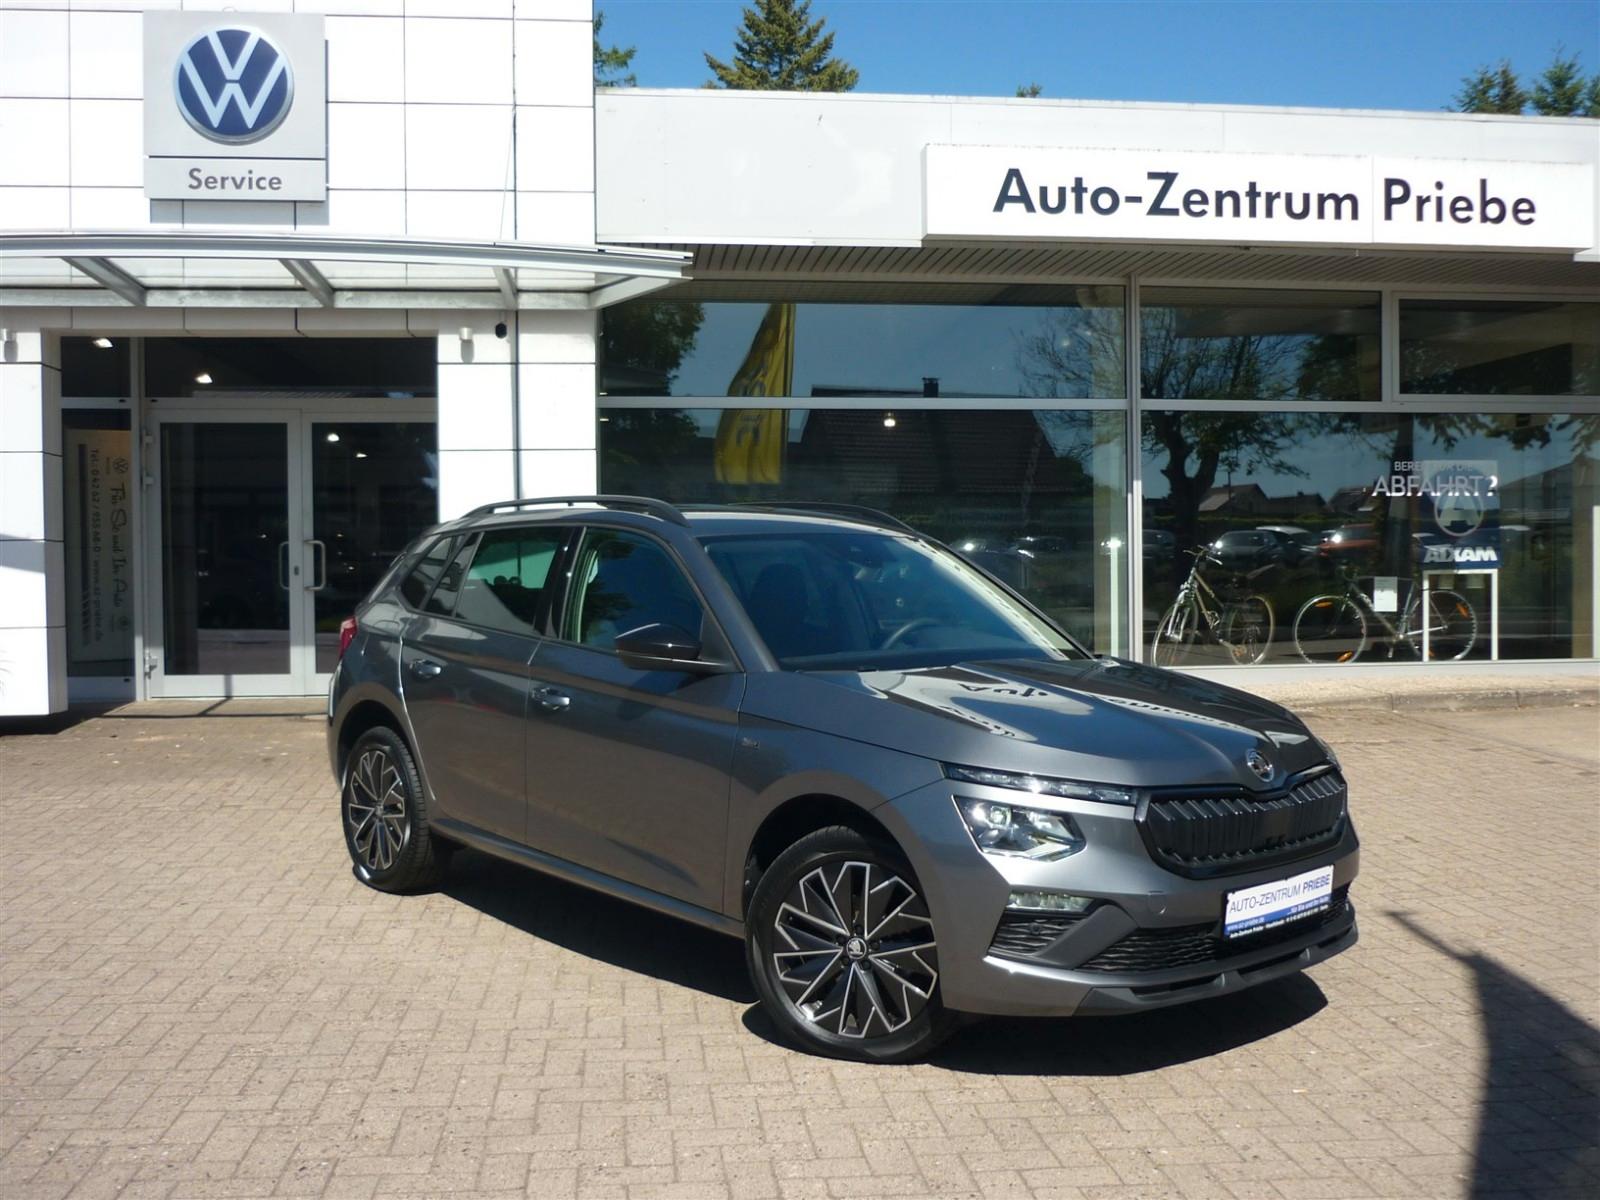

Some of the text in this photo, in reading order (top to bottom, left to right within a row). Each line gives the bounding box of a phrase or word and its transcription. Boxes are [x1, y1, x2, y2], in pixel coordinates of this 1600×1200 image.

[177, 27, 291, 137] VW
[188, 167, 282, 191] Service
[992, 167, 1536, 226] Auto-Zentrum Priebe
[1371, 475, 1498, 497] ABFAHRT?
[1229, 883, 1301, 914] AUTO-ZENTRUM
[1302, 873, 1331, 894] PRIEBE
